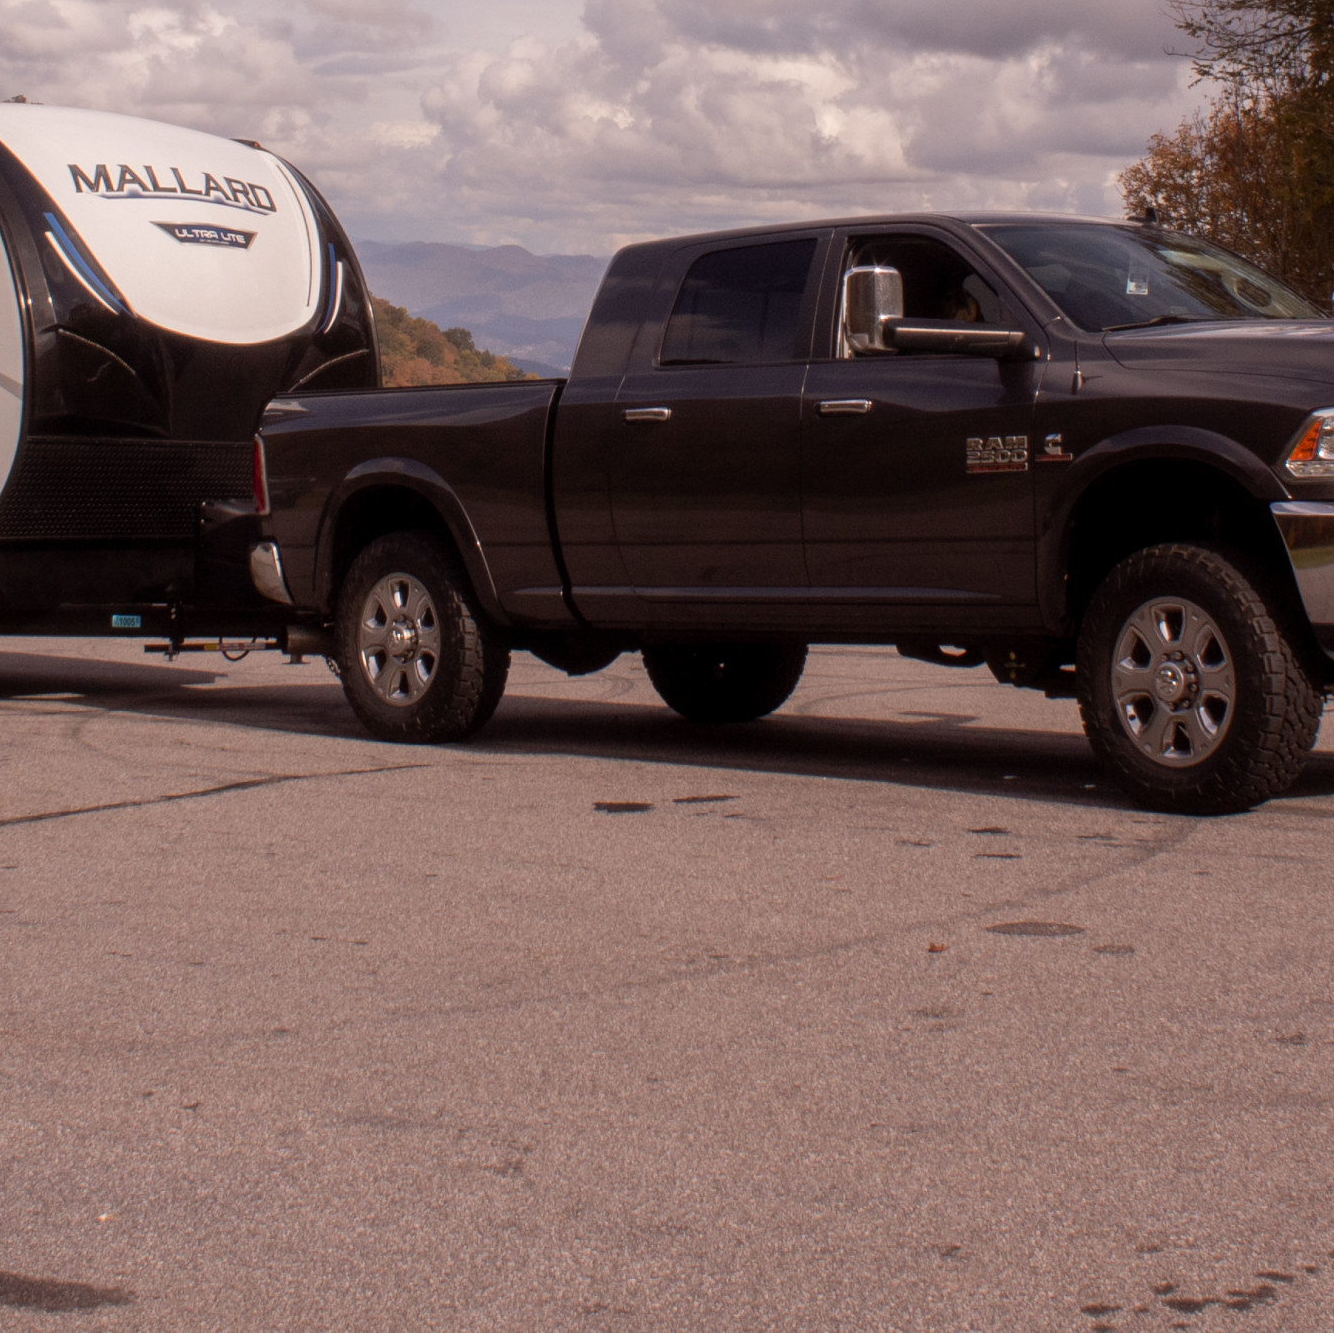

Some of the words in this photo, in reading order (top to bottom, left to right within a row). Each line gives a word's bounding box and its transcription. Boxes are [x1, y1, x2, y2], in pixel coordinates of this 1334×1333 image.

[67, 164, 277, 213] MALLARD
[174, 228, 219, 239] ULTRA
[220, 232, 247, 244] LITE
[966, 435, 1028, 451] RAM
[966, 449, 1028, 464] 2500
